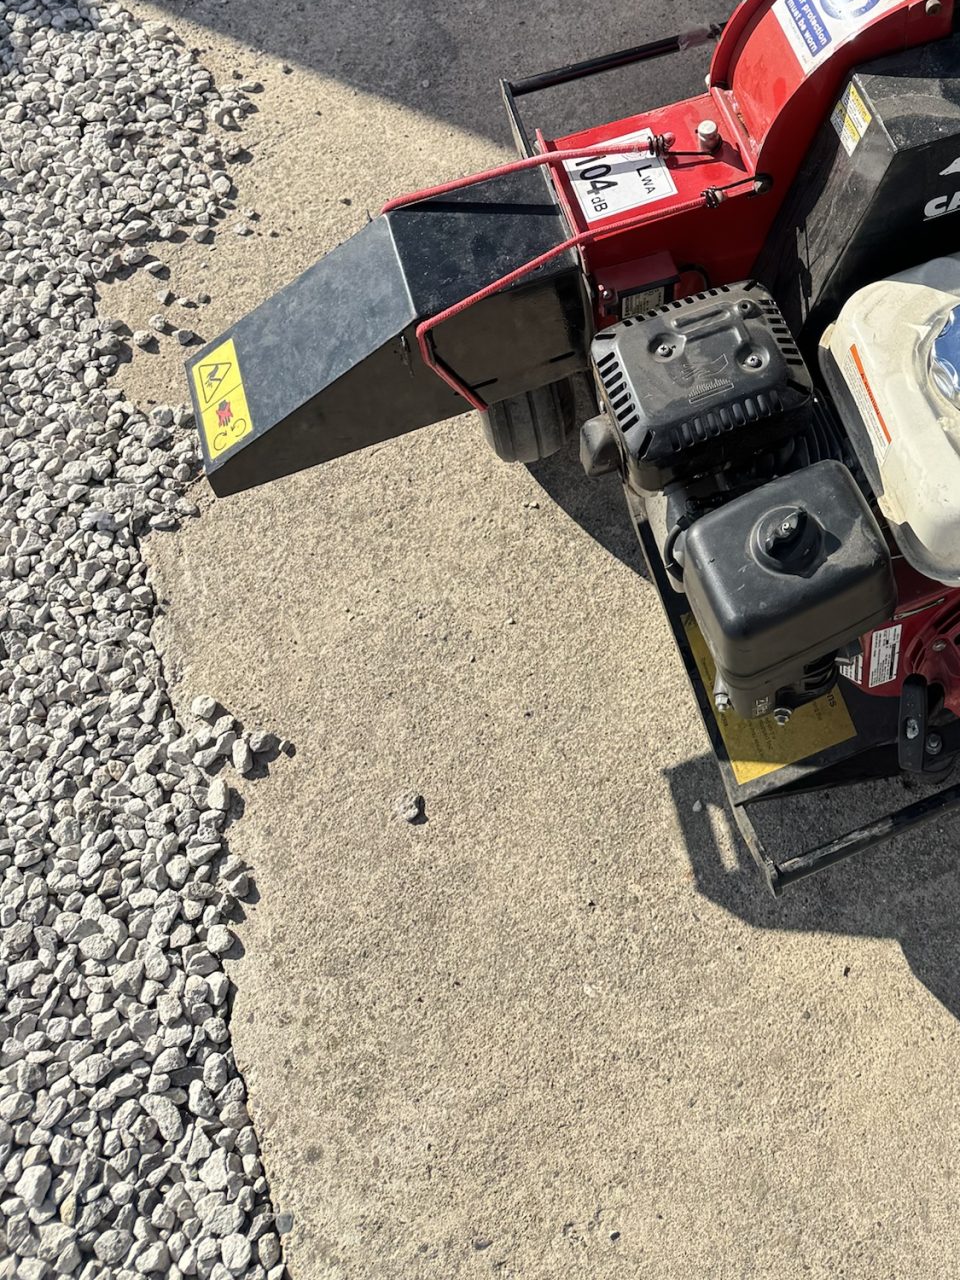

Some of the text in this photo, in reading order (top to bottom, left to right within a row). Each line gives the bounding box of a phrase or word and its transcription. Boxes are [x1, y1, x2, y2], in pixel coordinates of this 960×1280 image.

[797, 17, 807, 32] be
[803, 29, 818, 53] worn
[801, 4, 828, 46] protection
